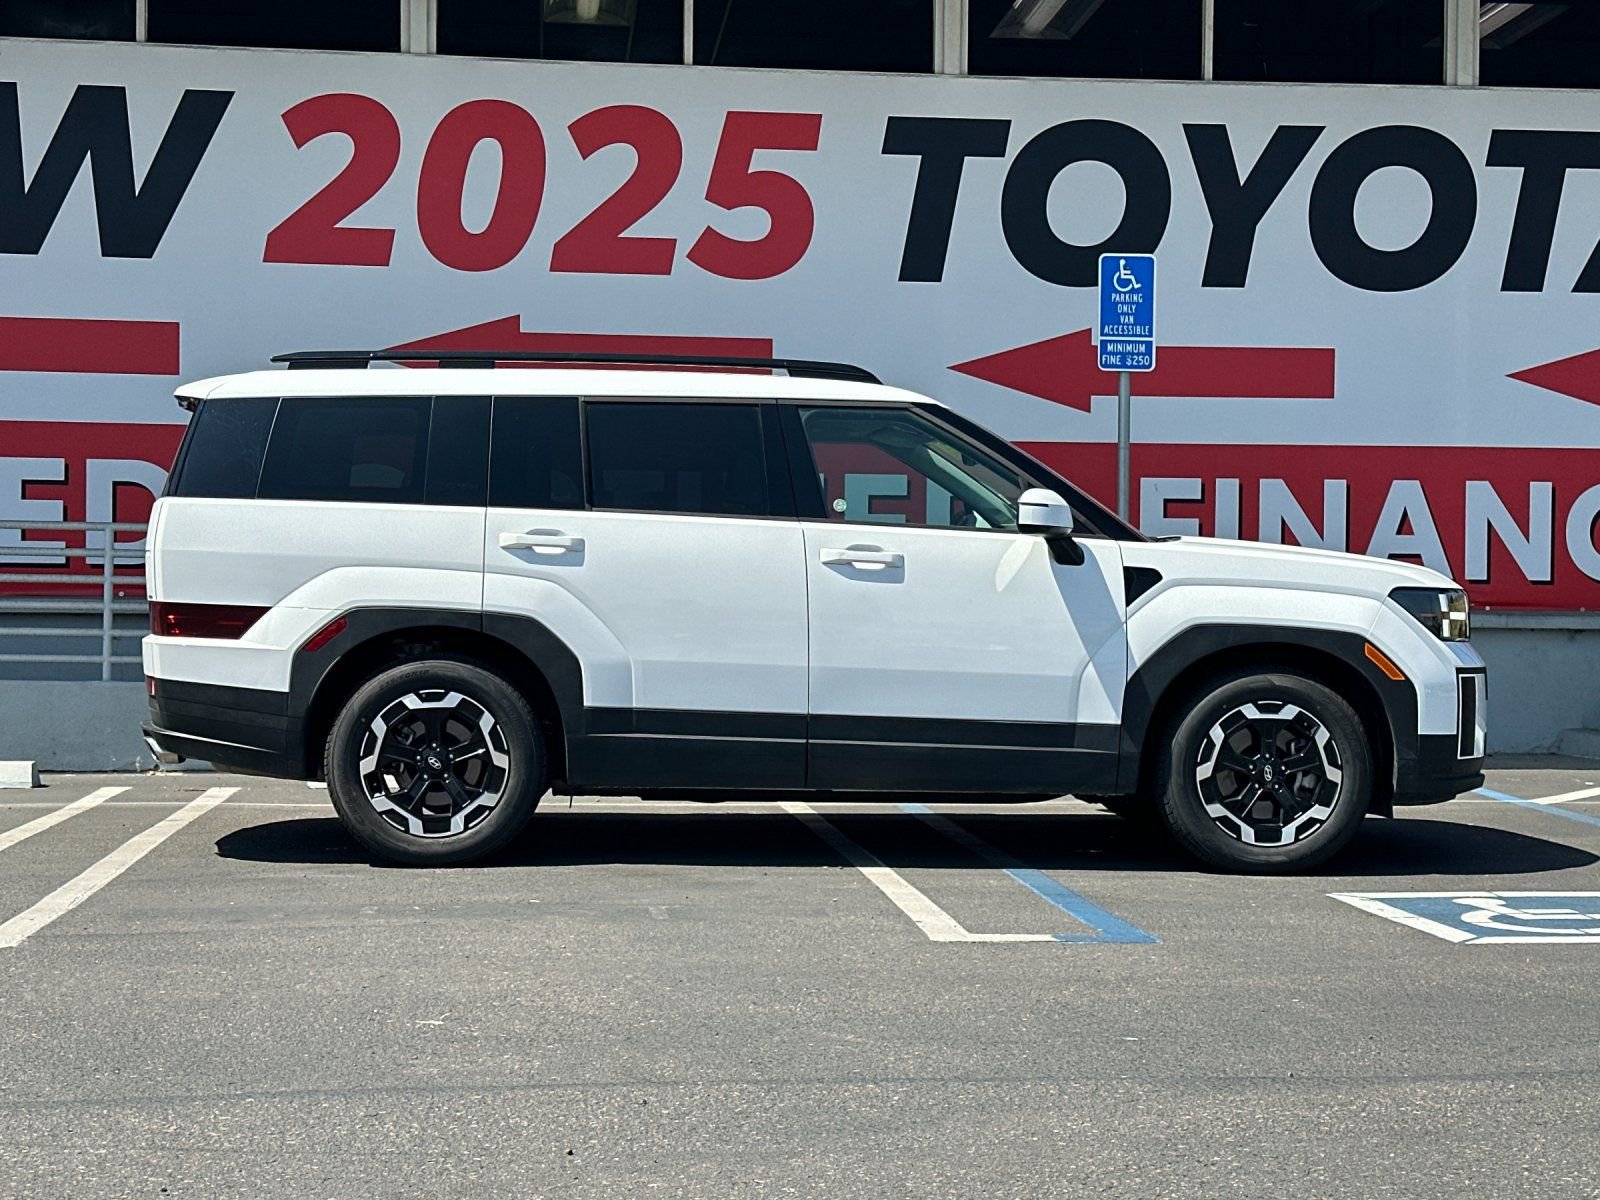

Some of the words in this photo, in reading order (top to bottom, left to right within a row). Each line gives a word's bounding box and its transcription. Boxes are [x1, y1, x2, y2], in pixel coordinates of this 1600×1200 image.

[262, 93, 822, 281] 2025
[881, 116, 1600, 293] TOYOT
[1111, 293, 1143, 303] PARKING
[1117, 304, 1136, 313] ONLY
[1120, 315, 1134, 324] VAN
[1103, 325, 1149, 335] ACCESSIBLE
[1107, 342, 1146, 353] MINIMUM
[1102, 355, 1121, 365] FINE
[1125, 355, 1150, 366] $250
